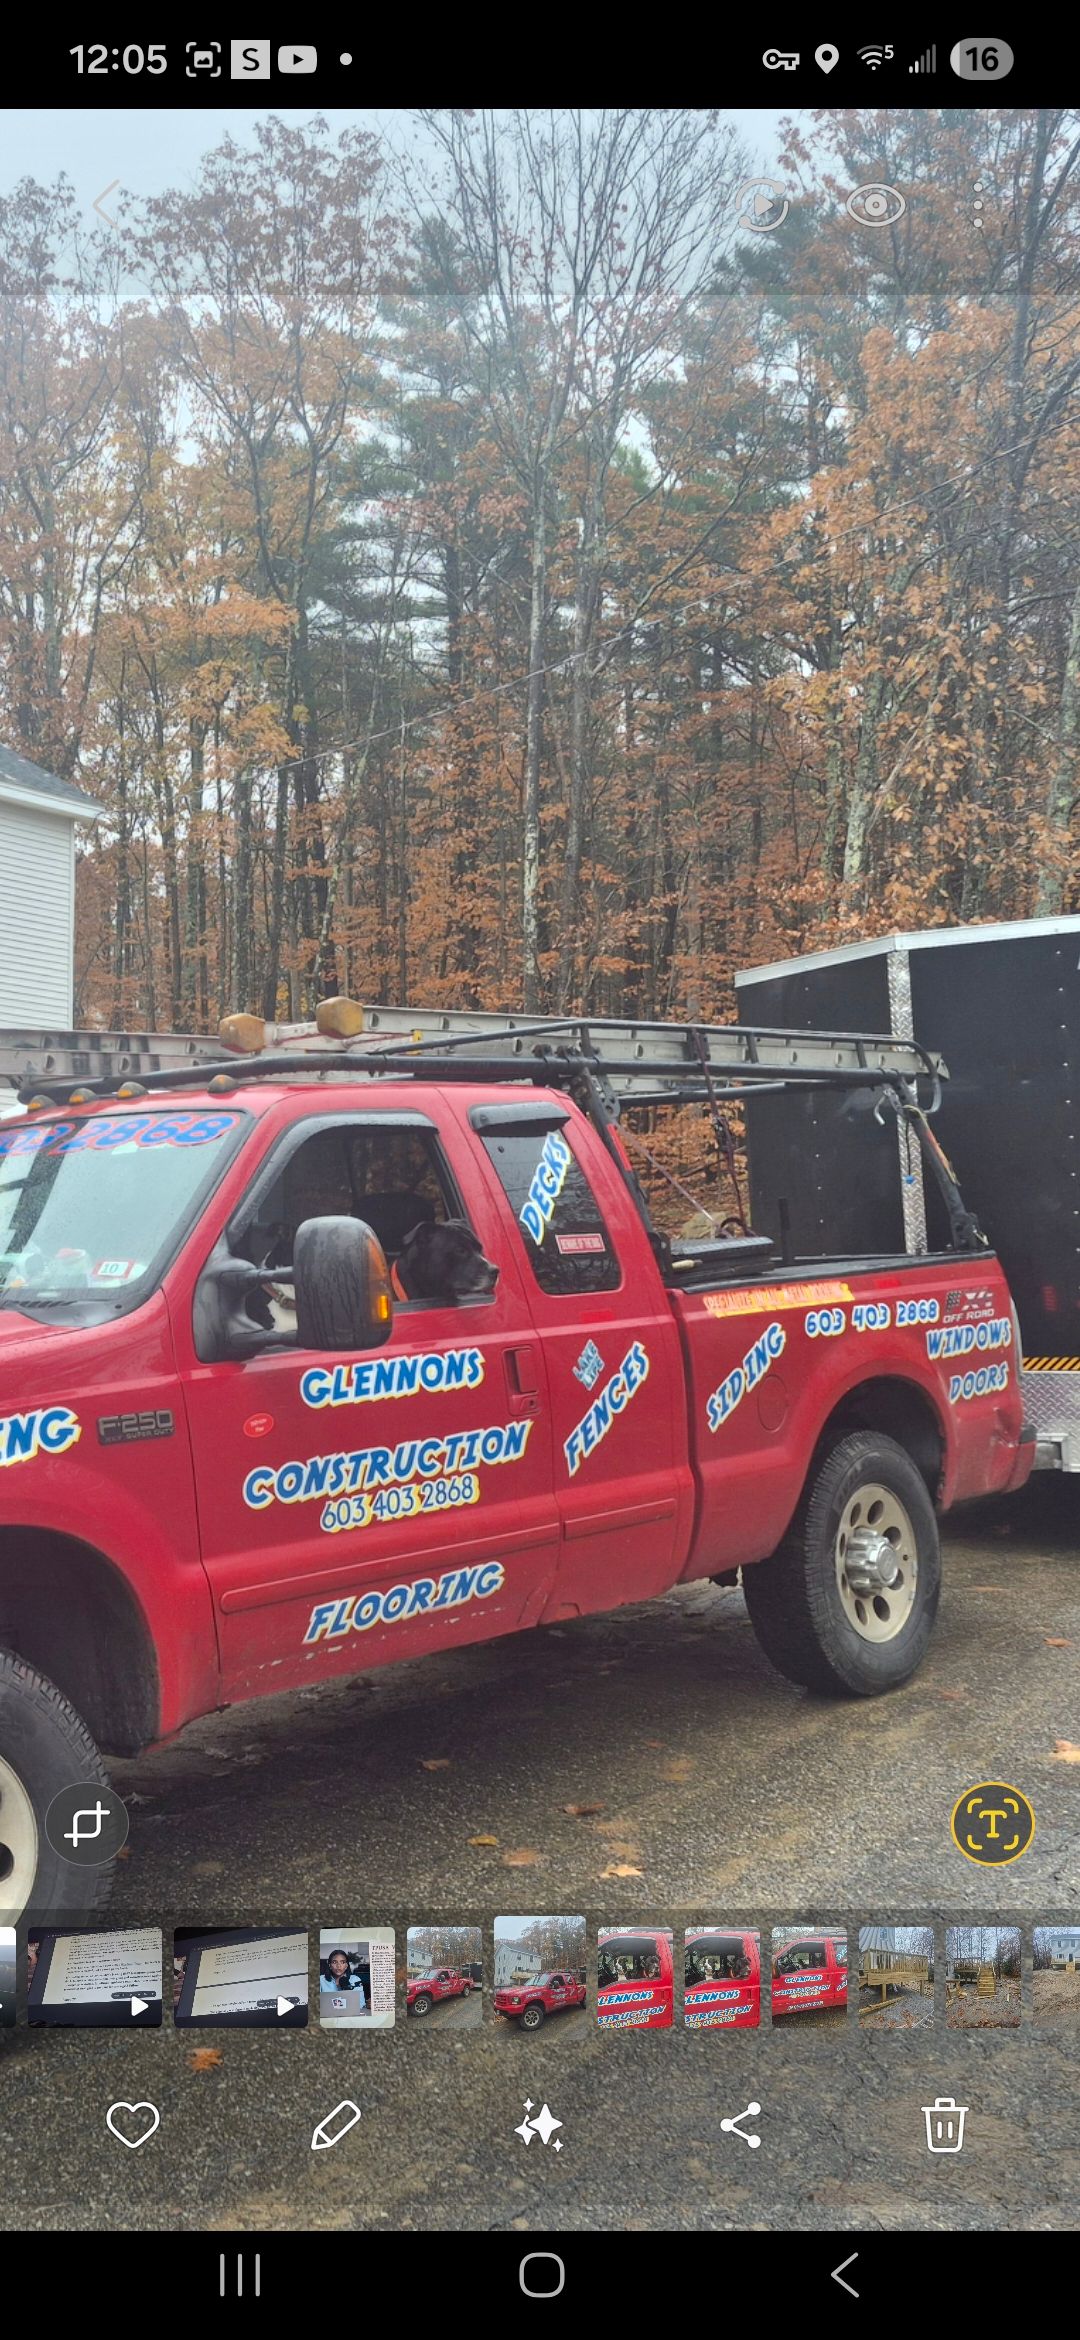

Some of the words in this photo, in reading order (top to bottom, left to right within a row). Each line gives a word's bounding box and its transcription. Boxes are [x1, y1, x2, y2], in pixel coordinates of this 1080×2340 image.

[49, 1113, 240, 1155] 2868
[520, 1129, 570, 1246] DECKS
[805, 1309, 845, 1337] 603
[852, 1302, 890, 1331] 403
[896, 1298, 939, 1326] 2868
[926, 1317, 1012, 1360] WINDOWS
[301, 1349, 485, 1407] GLENNONS
[706, 1322, 787, 1434] SIDING
[950, 1361, 1010, 1404] DOORS
[0, 1406, 81, 1466] NG
[563, 1341, 650, 1477] FENCES
[243, 1419, 533, 1509] CONSTRUCTION
[321, 1498, 370, 1532] 603
[371, 1484, 420, 1519] 403
[421, 1474, 478, 1510] 2868
[303, 1561, 504, 1643] FLOORING
